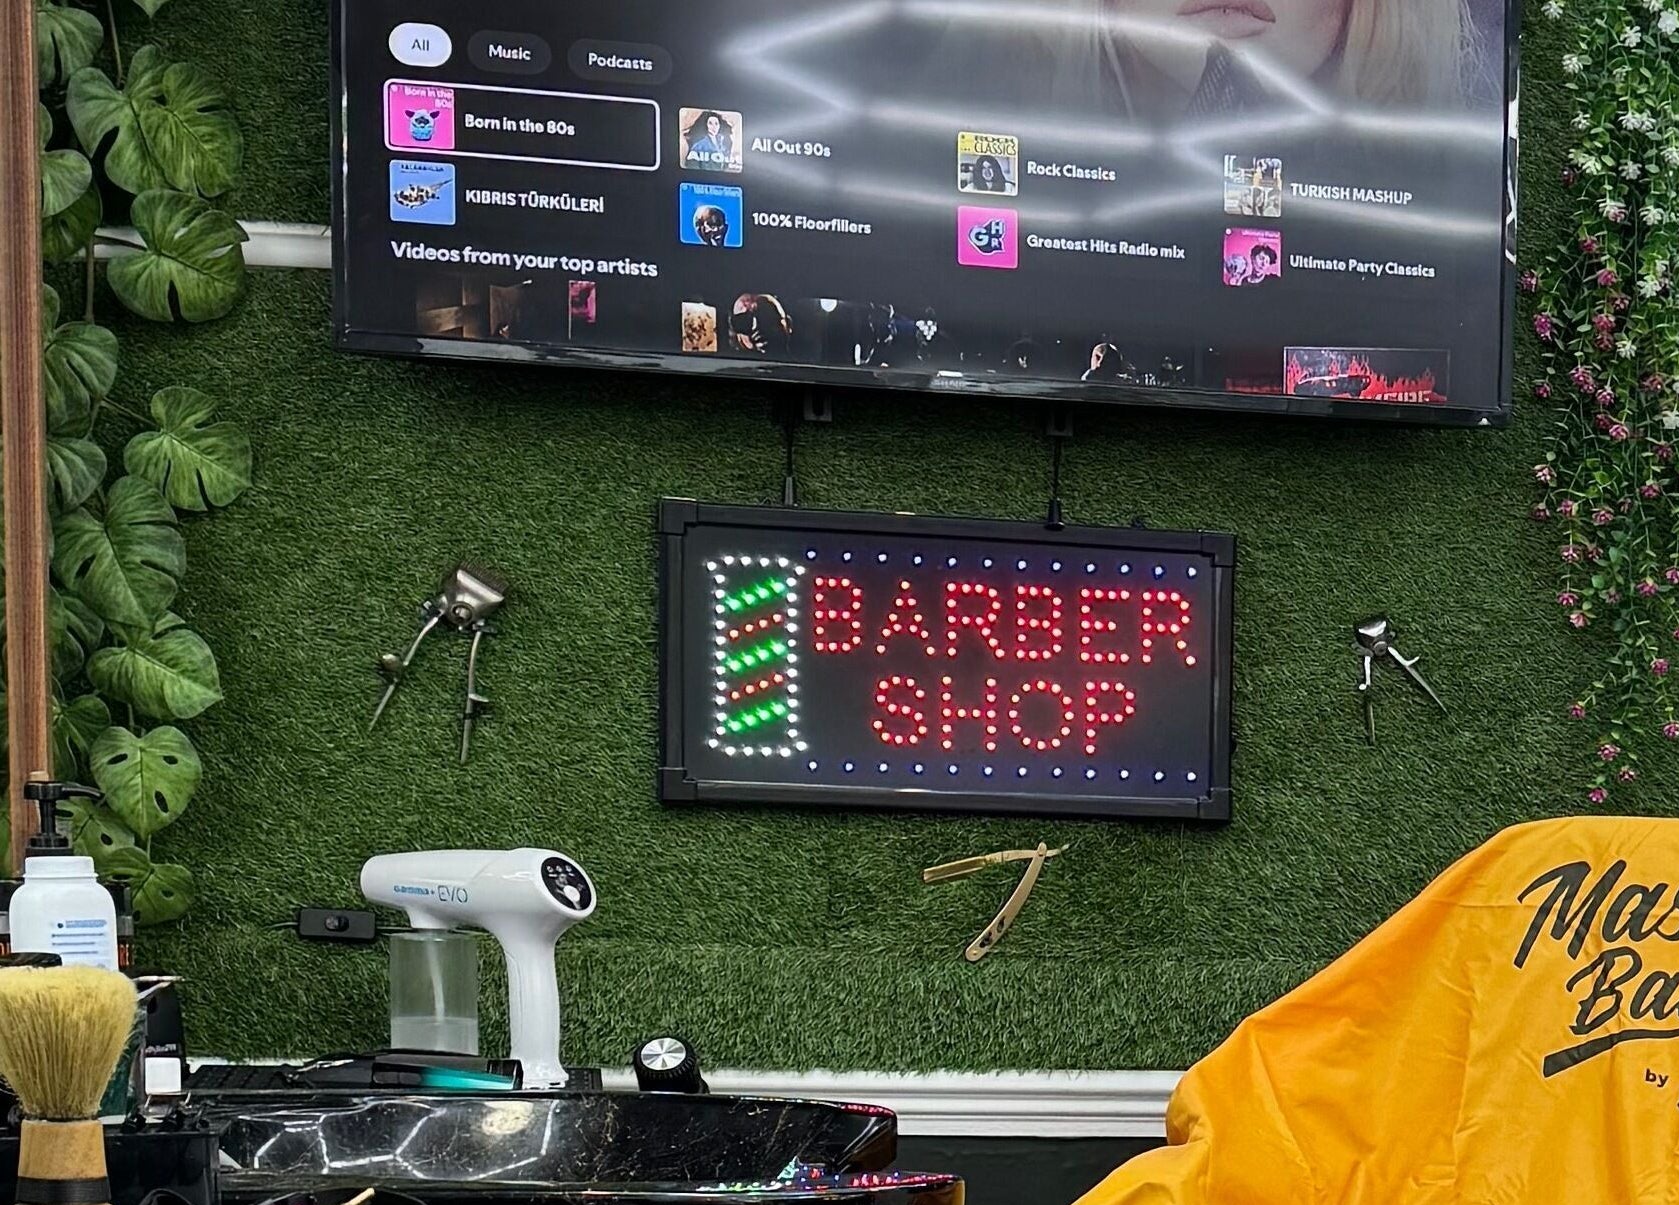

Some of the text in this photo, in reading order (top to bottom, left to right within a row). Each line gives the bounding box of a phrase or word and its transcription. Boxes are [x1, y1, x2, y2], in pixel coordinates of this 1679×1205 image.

[411, 38, 430, 52] All
[488, 44, 531, 61] Music
[588, 52, 653, 72] Podcasts
[465, 113, 575, 136] Born in the 80s
[752, 137, 831, 158] All Out 90s
[1027, 160, 1116, 181] Rock Classics
[465, 188, 604, 213] KIBRIS TÜRKÜLERİ
[1290, 183, 1413, 205] TURKISH MASHUP
[752, 212, 872, 235] 100% Floorfillers
[1027, 234, 1186, 260] Greatest Hits Radio mix
[391, 240, 658, 278] Videos from your top artists
[1290, 254, 1436, 278] Ultimate Party Classics
[812, 576, 1198, 667] BARBER
[871, 674, 1137, 755] SHOP
[437, 884, 468, 903] EVO
[1645, 1068, 1669, 1088] by
